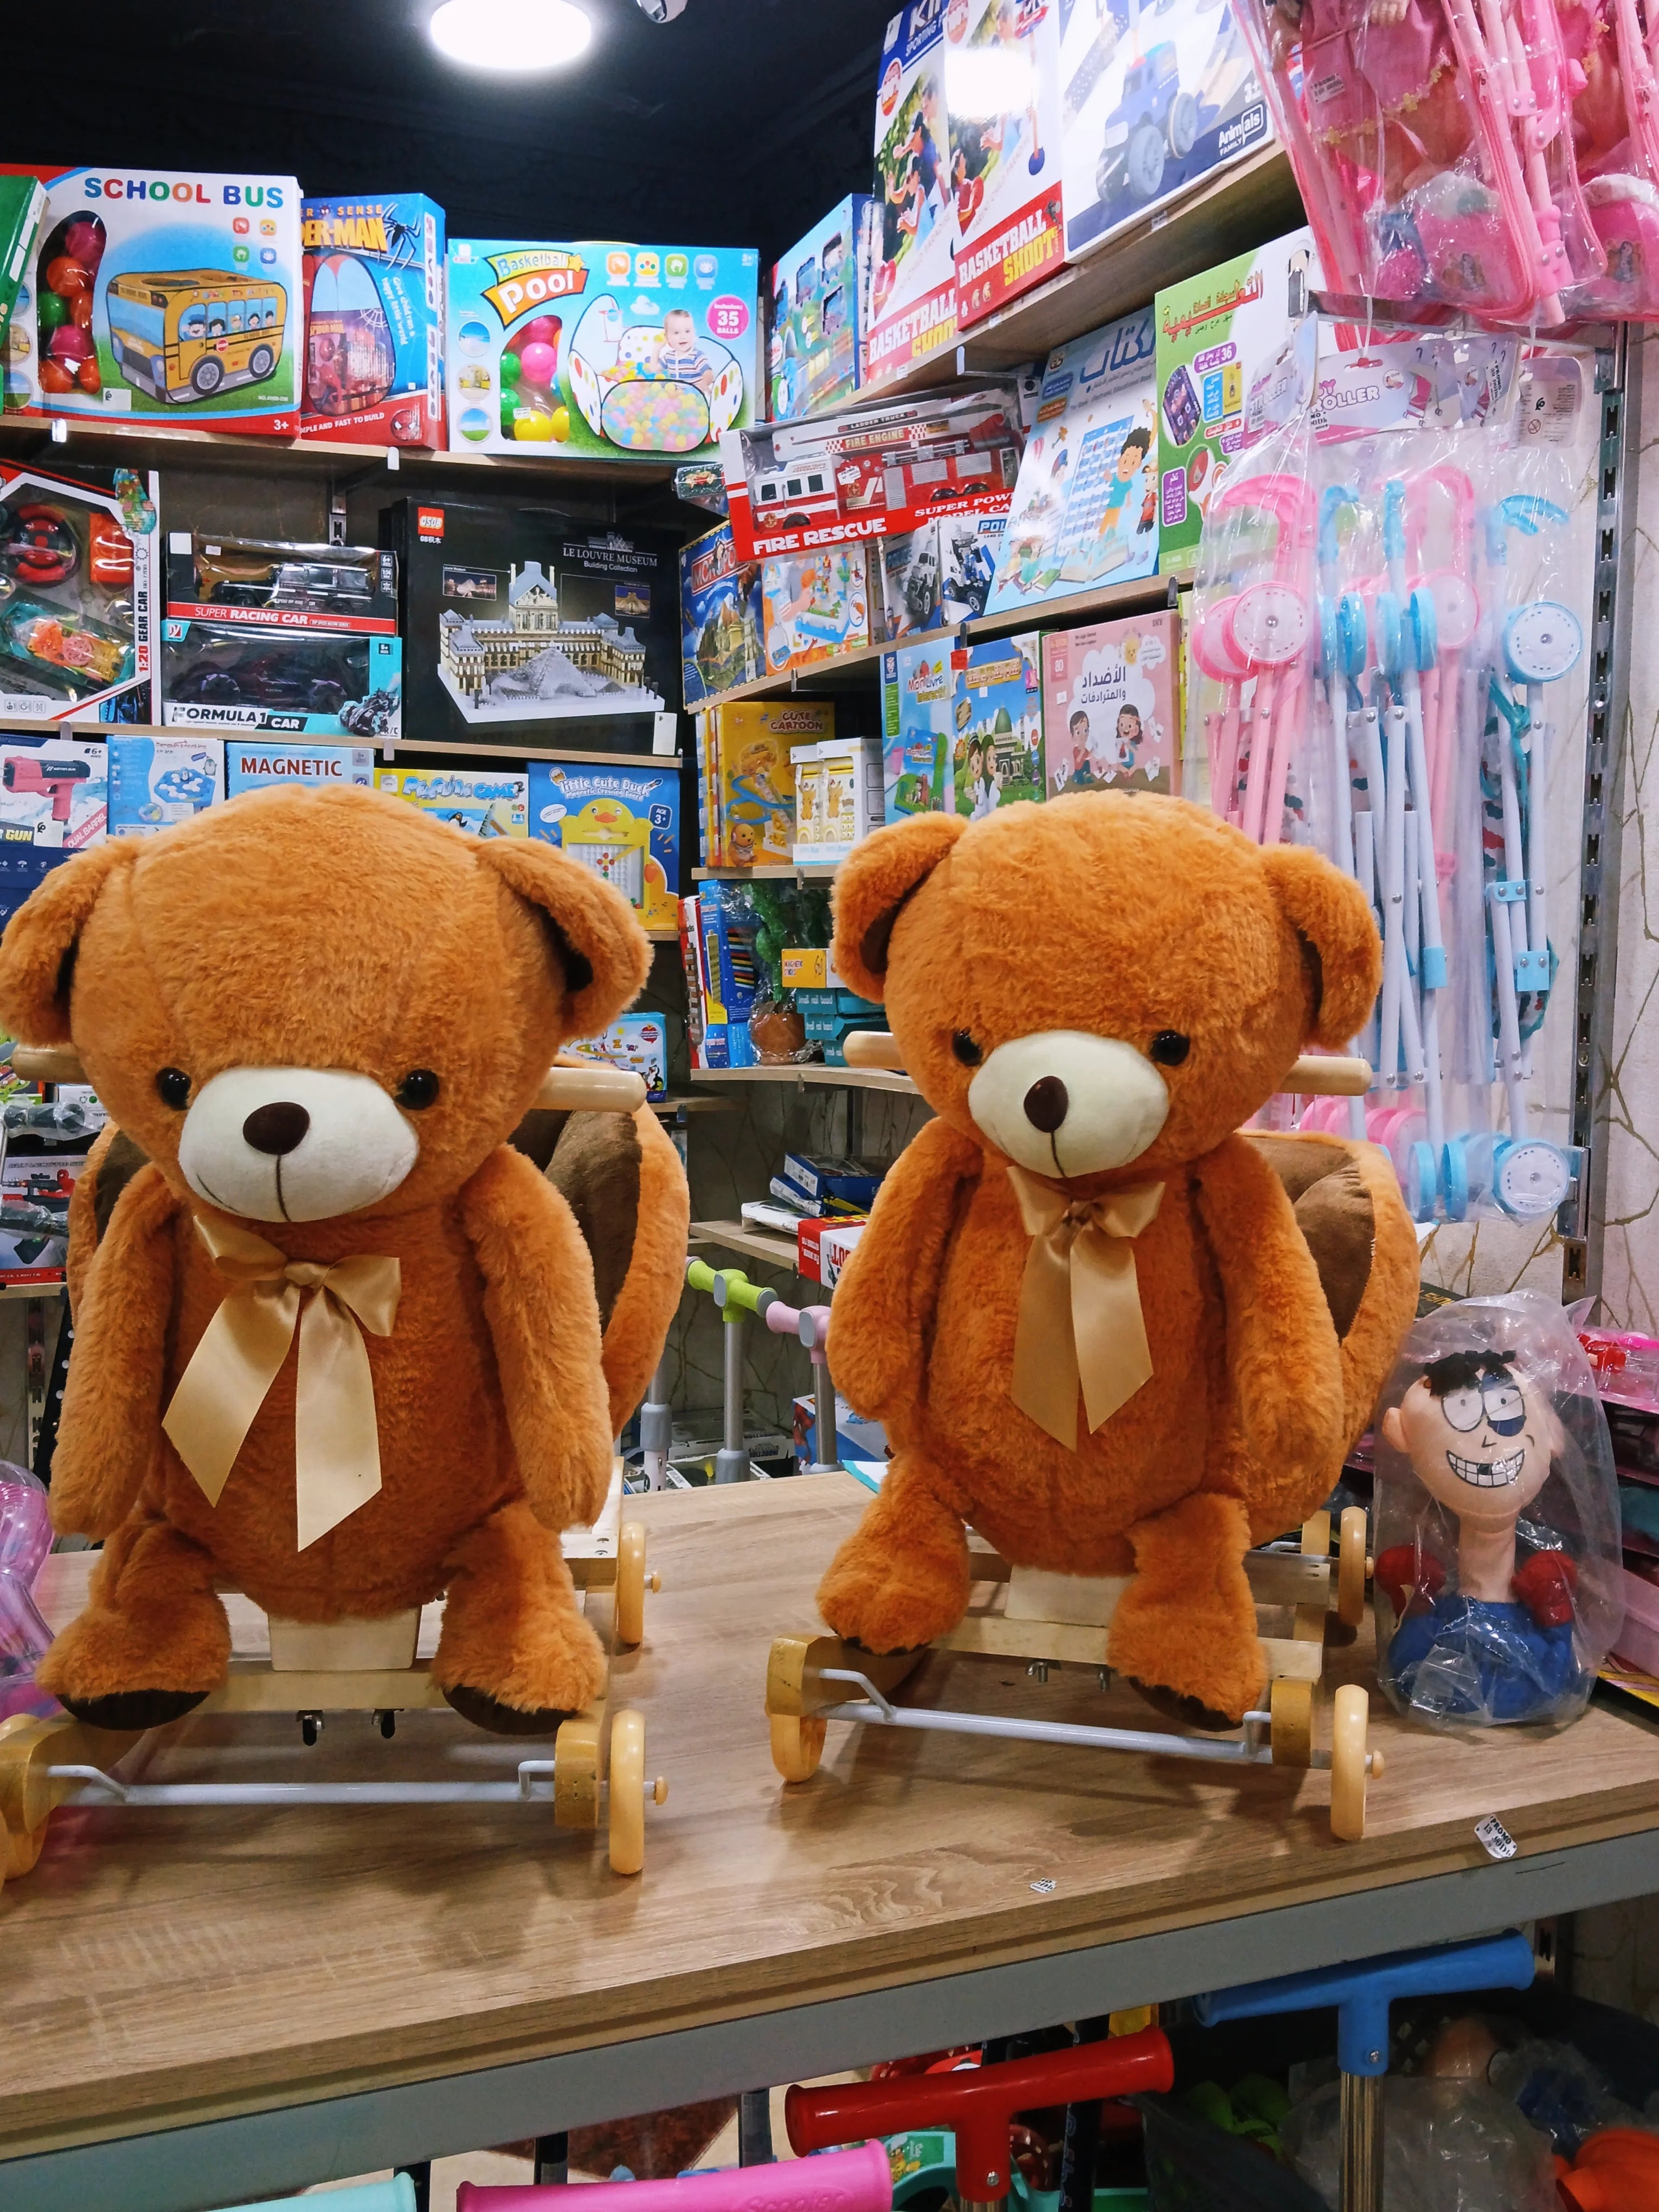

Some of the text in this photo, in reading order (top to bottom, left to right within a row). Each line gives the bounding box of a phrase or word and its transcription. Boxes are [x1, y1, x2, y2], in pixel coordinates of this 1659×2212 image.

[1219, 113, 1260, 147] Animals
[85, 177, 283, 208] SCHOOL BUS
[337, 204, 382, 216] SENSE
[959, 209, 1046, 288] BASKETBALL
[1004, 227, 1057, 286] SHOOT
[497, 253, 567, 277] Basketball
[717, 311, 739, 326] 35
[869, 288, 958, 365] BASKETBALL
[1221, 345, 1232, 361] 36
[274, 420, 289, 430] 3+
[319, 421, 332, 430] AND
[335, 418, 351, 428] FAST
[354, 416, 363, 425] TO
[364, 413, 384, 423] BUILD
[881, 413, 905, 422] TRUCK
[845, 429, 905, 448] FIRE ENGINE
[915, 500, 968, 517] SUPER
[753, 517, 886, 555] FIRE RESCUE
[563, 548, 657, 567] LE LOUVRE MUSEUM
[584, 561, 638, 573] Building Collection
[138, 591, 148, 612] CAR
[195, 607, 307, 624] SUPER RACING CAR
[138, 616, 148, 642] GEAR
[139, 646, 149, 672] 1:20
[1082, 664, 1126, 688] الأضداد
[1081, 689, 1126, 704] والمترادفات
[172, 707, 300, 729] FORMULA 1 CAR
[782, 710, 811, 721] CUTE
[770, 720, 823, 731] CARTOON
[241, 757, 343, 777] MAGNETIC
[560, 776, 650, 796] little Cute Duck
[654, 815, 666, 824] 3+
[5, 829, 33, 841] GUN
[68, 813, 107, 848] DUAL BARREL
[1483, 1823, 1493, 1834] 13
[1490, 1817, 1512, 1844] PROMO
